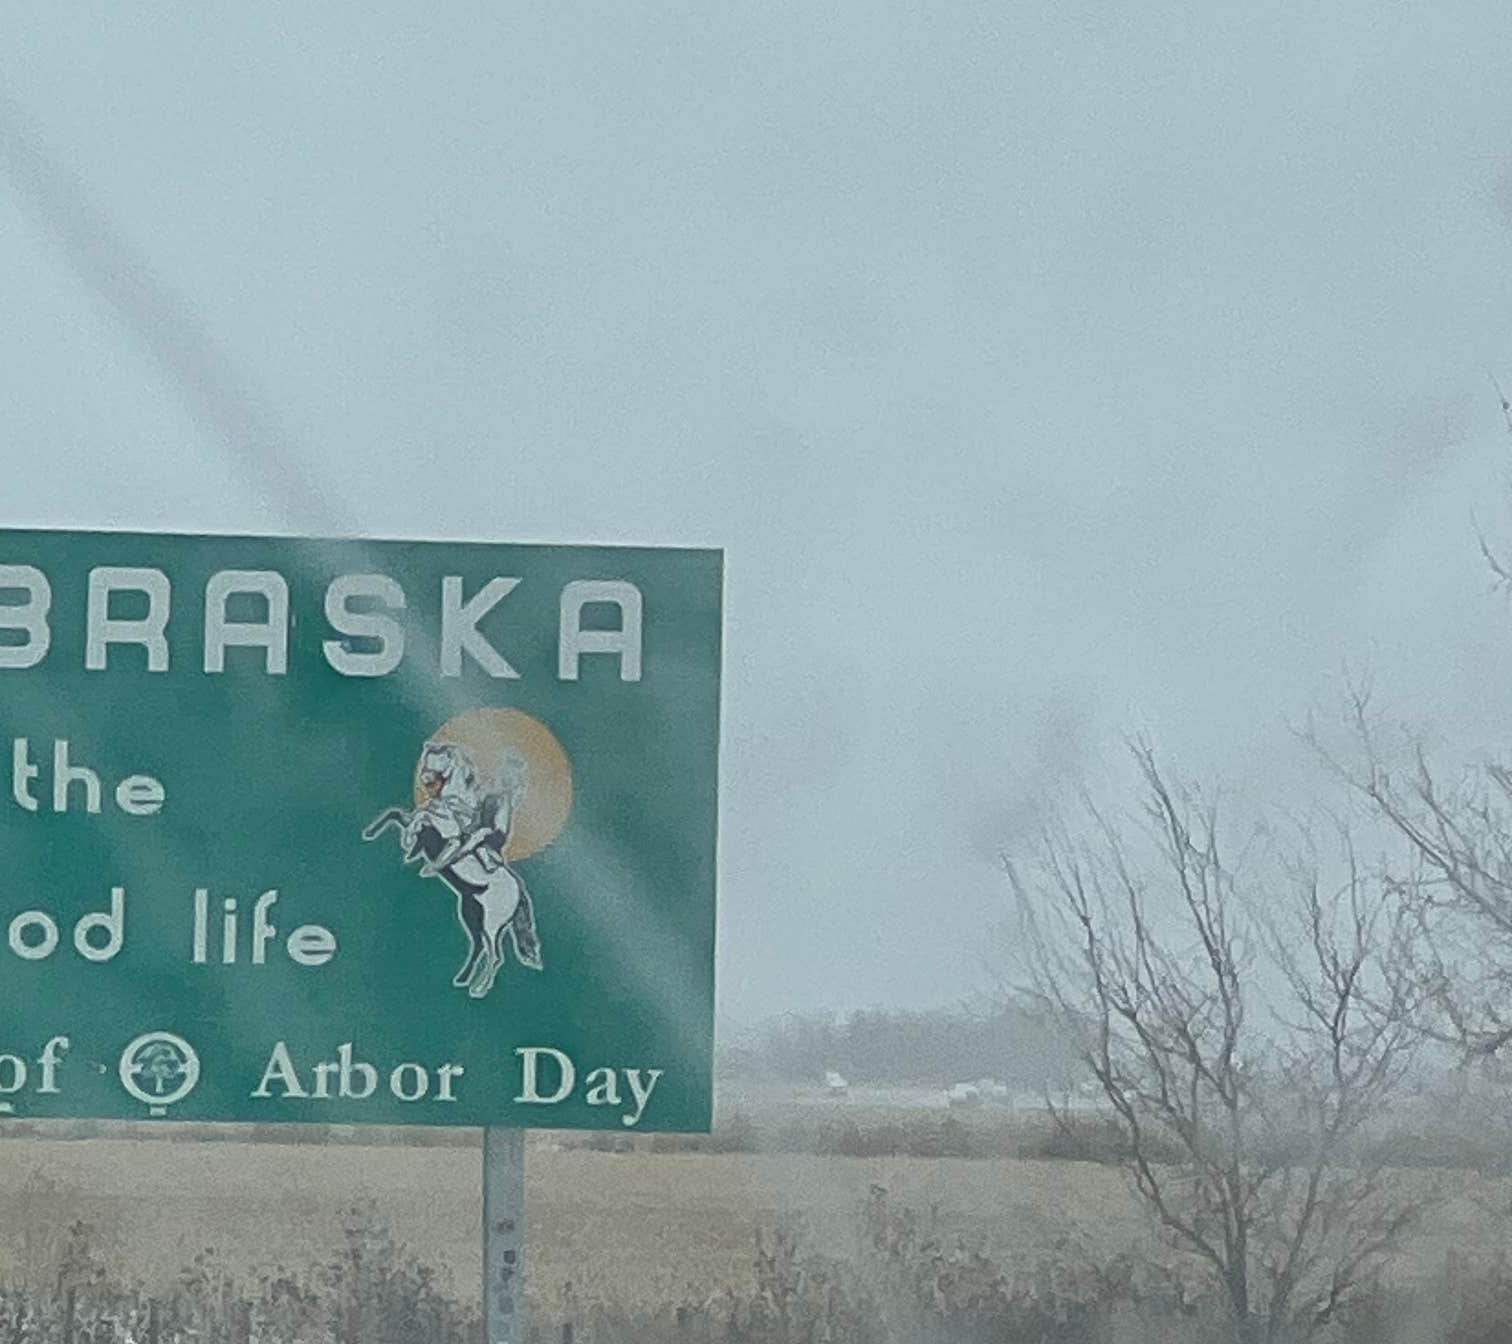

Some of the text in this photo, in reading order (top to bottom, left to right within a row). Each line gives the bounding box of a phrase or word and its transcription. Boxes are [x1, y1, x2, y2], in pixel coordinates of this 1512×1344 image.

[13, 737, 165, 815] the
[193, 888, 337, 966] life
[250, 1040, 464, 1102] Arbor
[513, 1047, 663, 1126] Day
